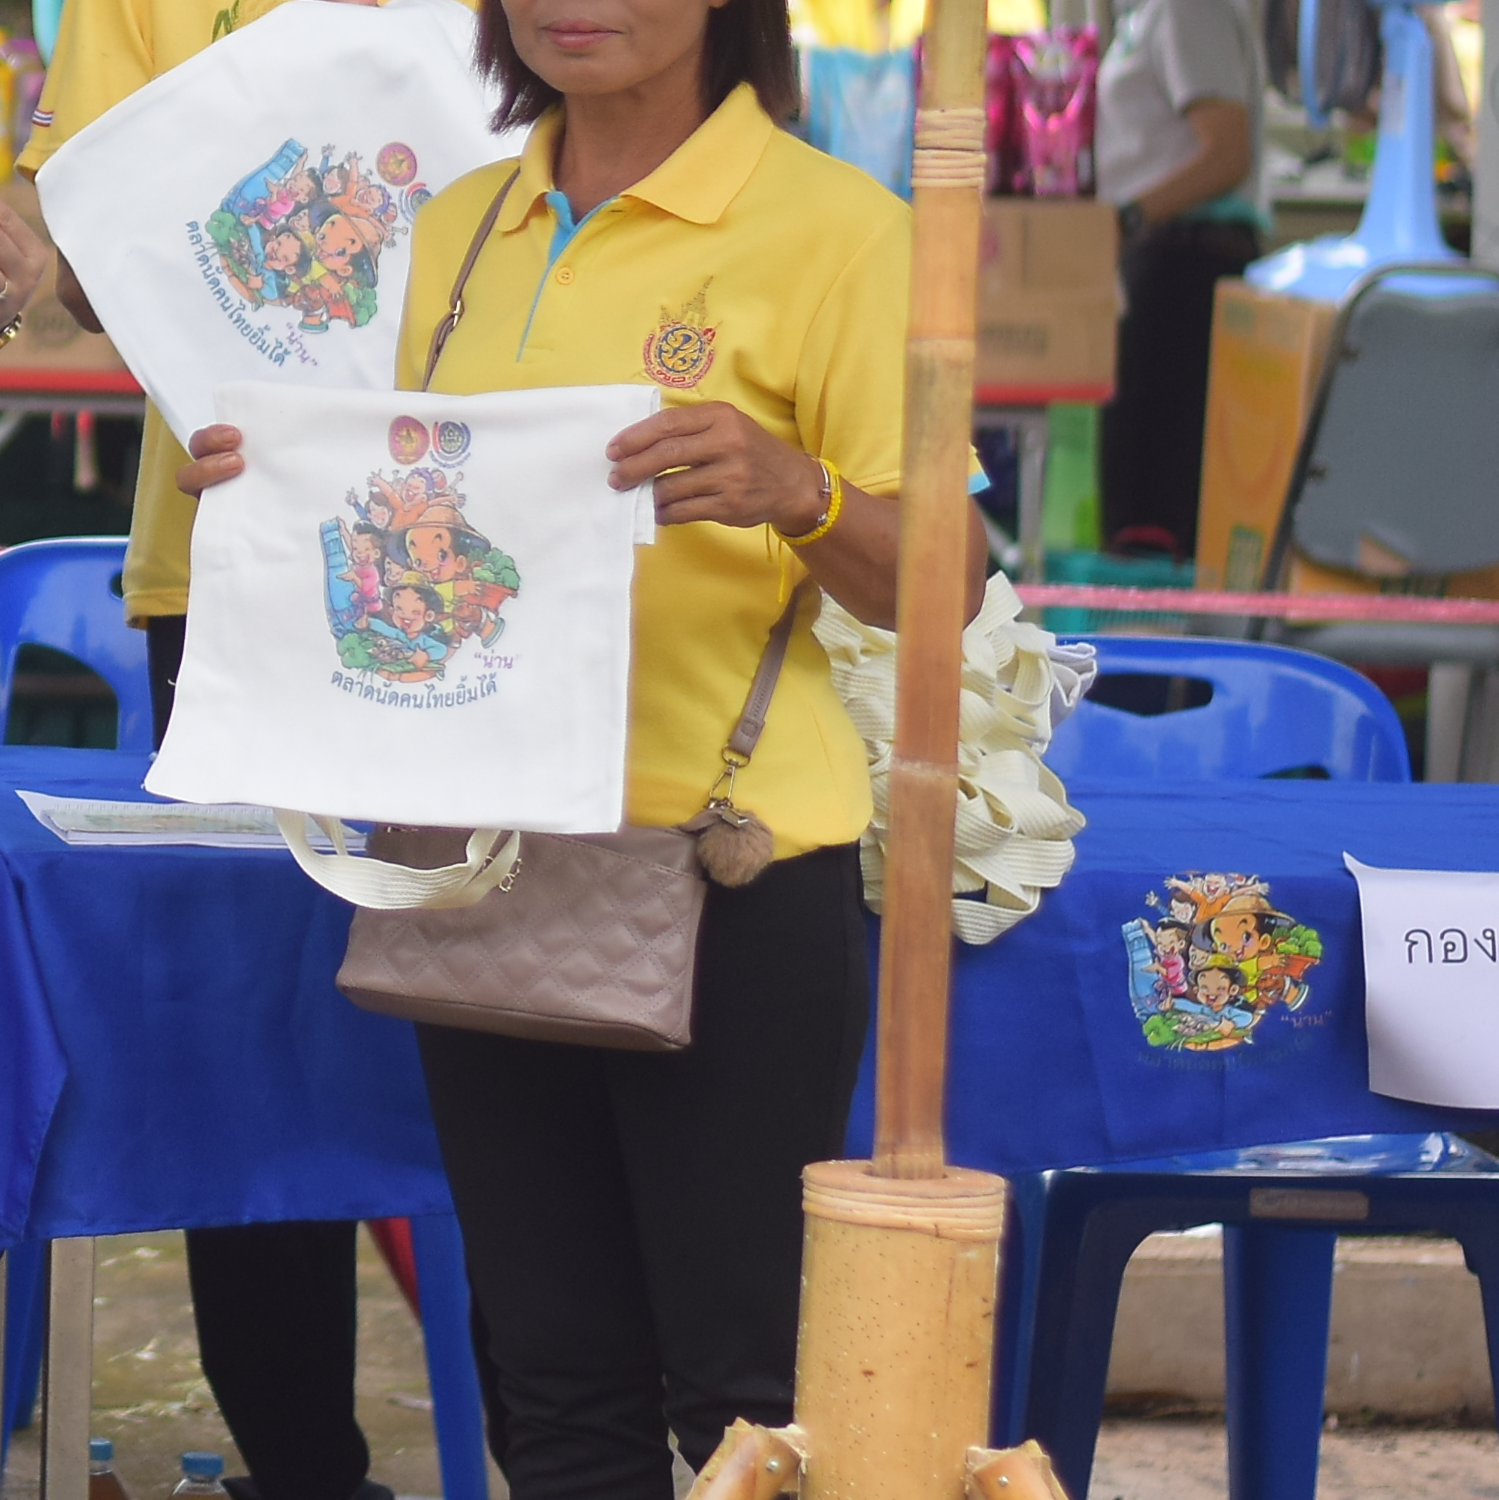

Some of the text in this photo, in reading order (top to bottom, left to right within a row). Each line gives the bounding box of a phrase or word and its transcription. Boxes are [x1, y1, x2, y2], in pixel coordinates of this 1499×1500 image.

[185, 220, 291, 367] ตลาดนัดคนไทยยิ้มได้
[285, 322, 318, 367] “น่าน”
[330, 669, 498, 710] ตลาดนัดคนไทยยิ้มได้
[1403, 927, 1499, 965] กอง
